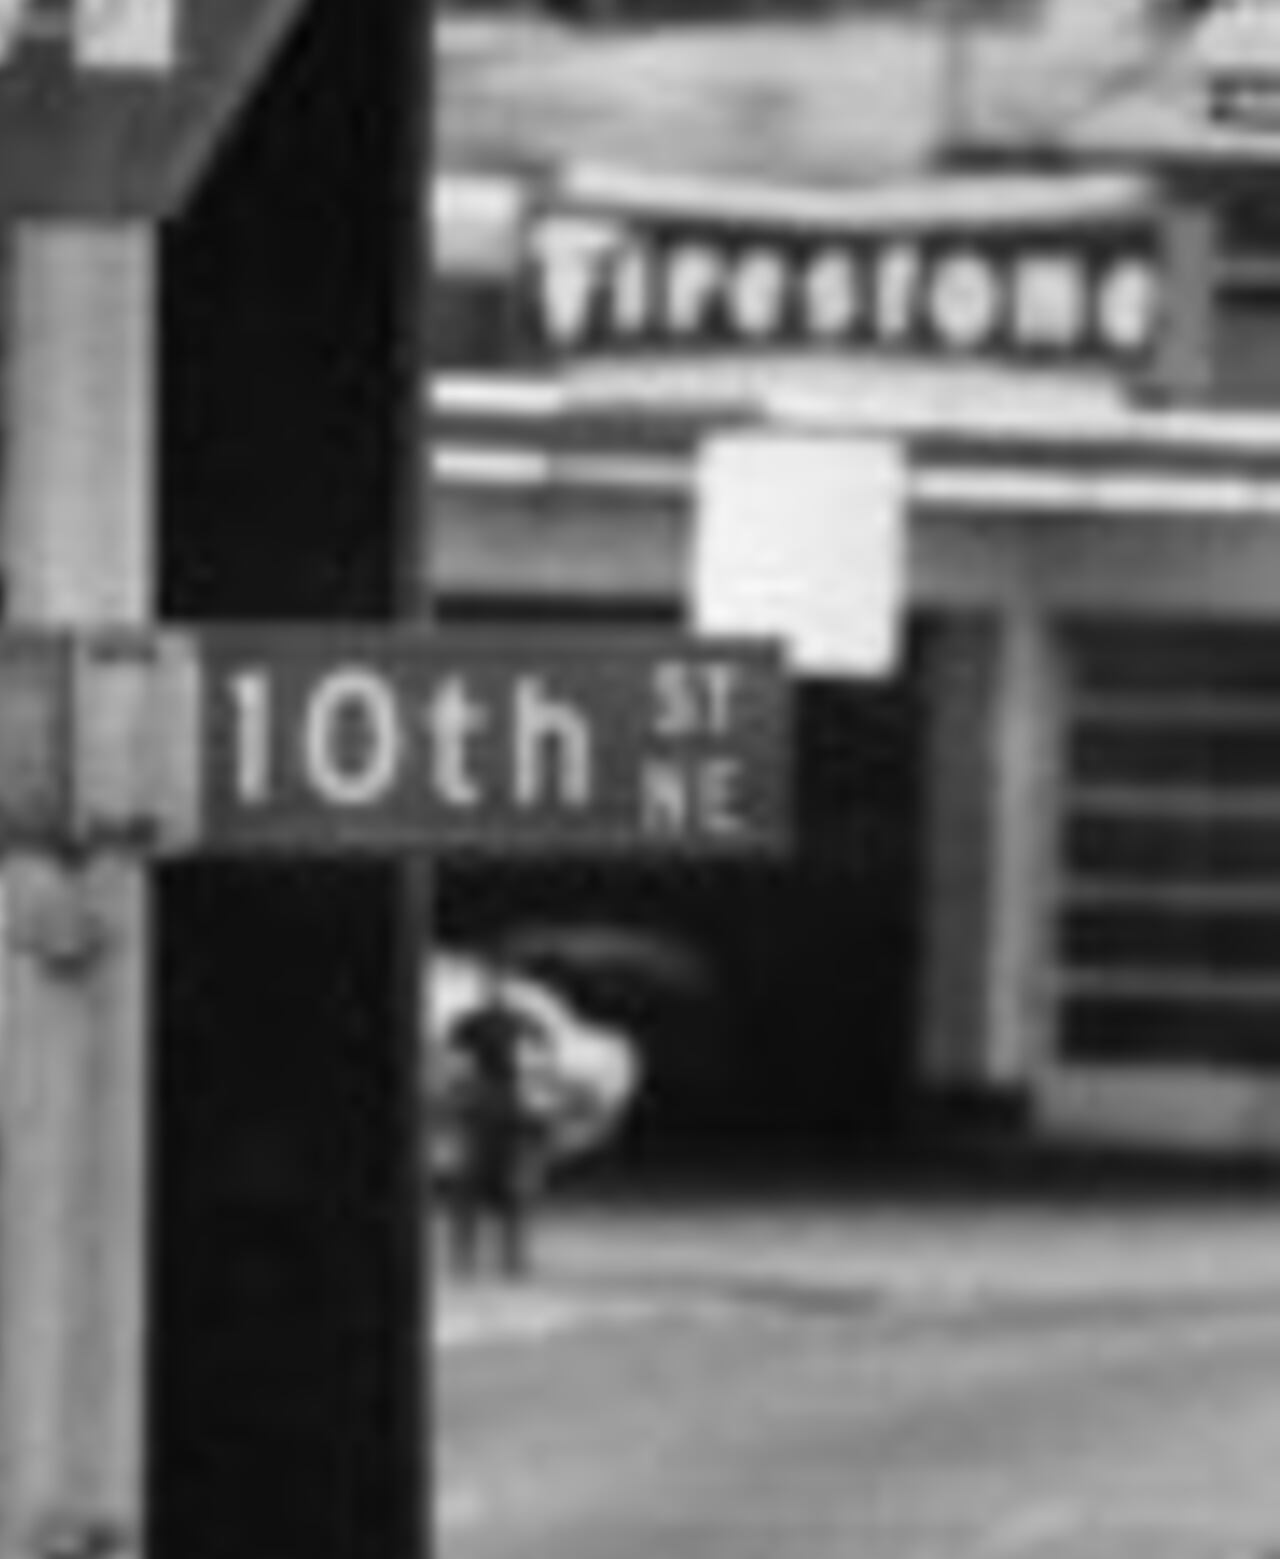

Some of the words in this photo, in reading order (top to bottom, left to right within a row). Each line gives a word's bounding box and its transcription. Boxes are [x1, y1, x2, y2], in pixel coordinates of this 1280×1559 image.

[530, 215, 1158, 350] Firestone
[228, 660, 590, 808] 10th
[648, 658, 738, 738] ST
[642, 758, 744, 838] NE
